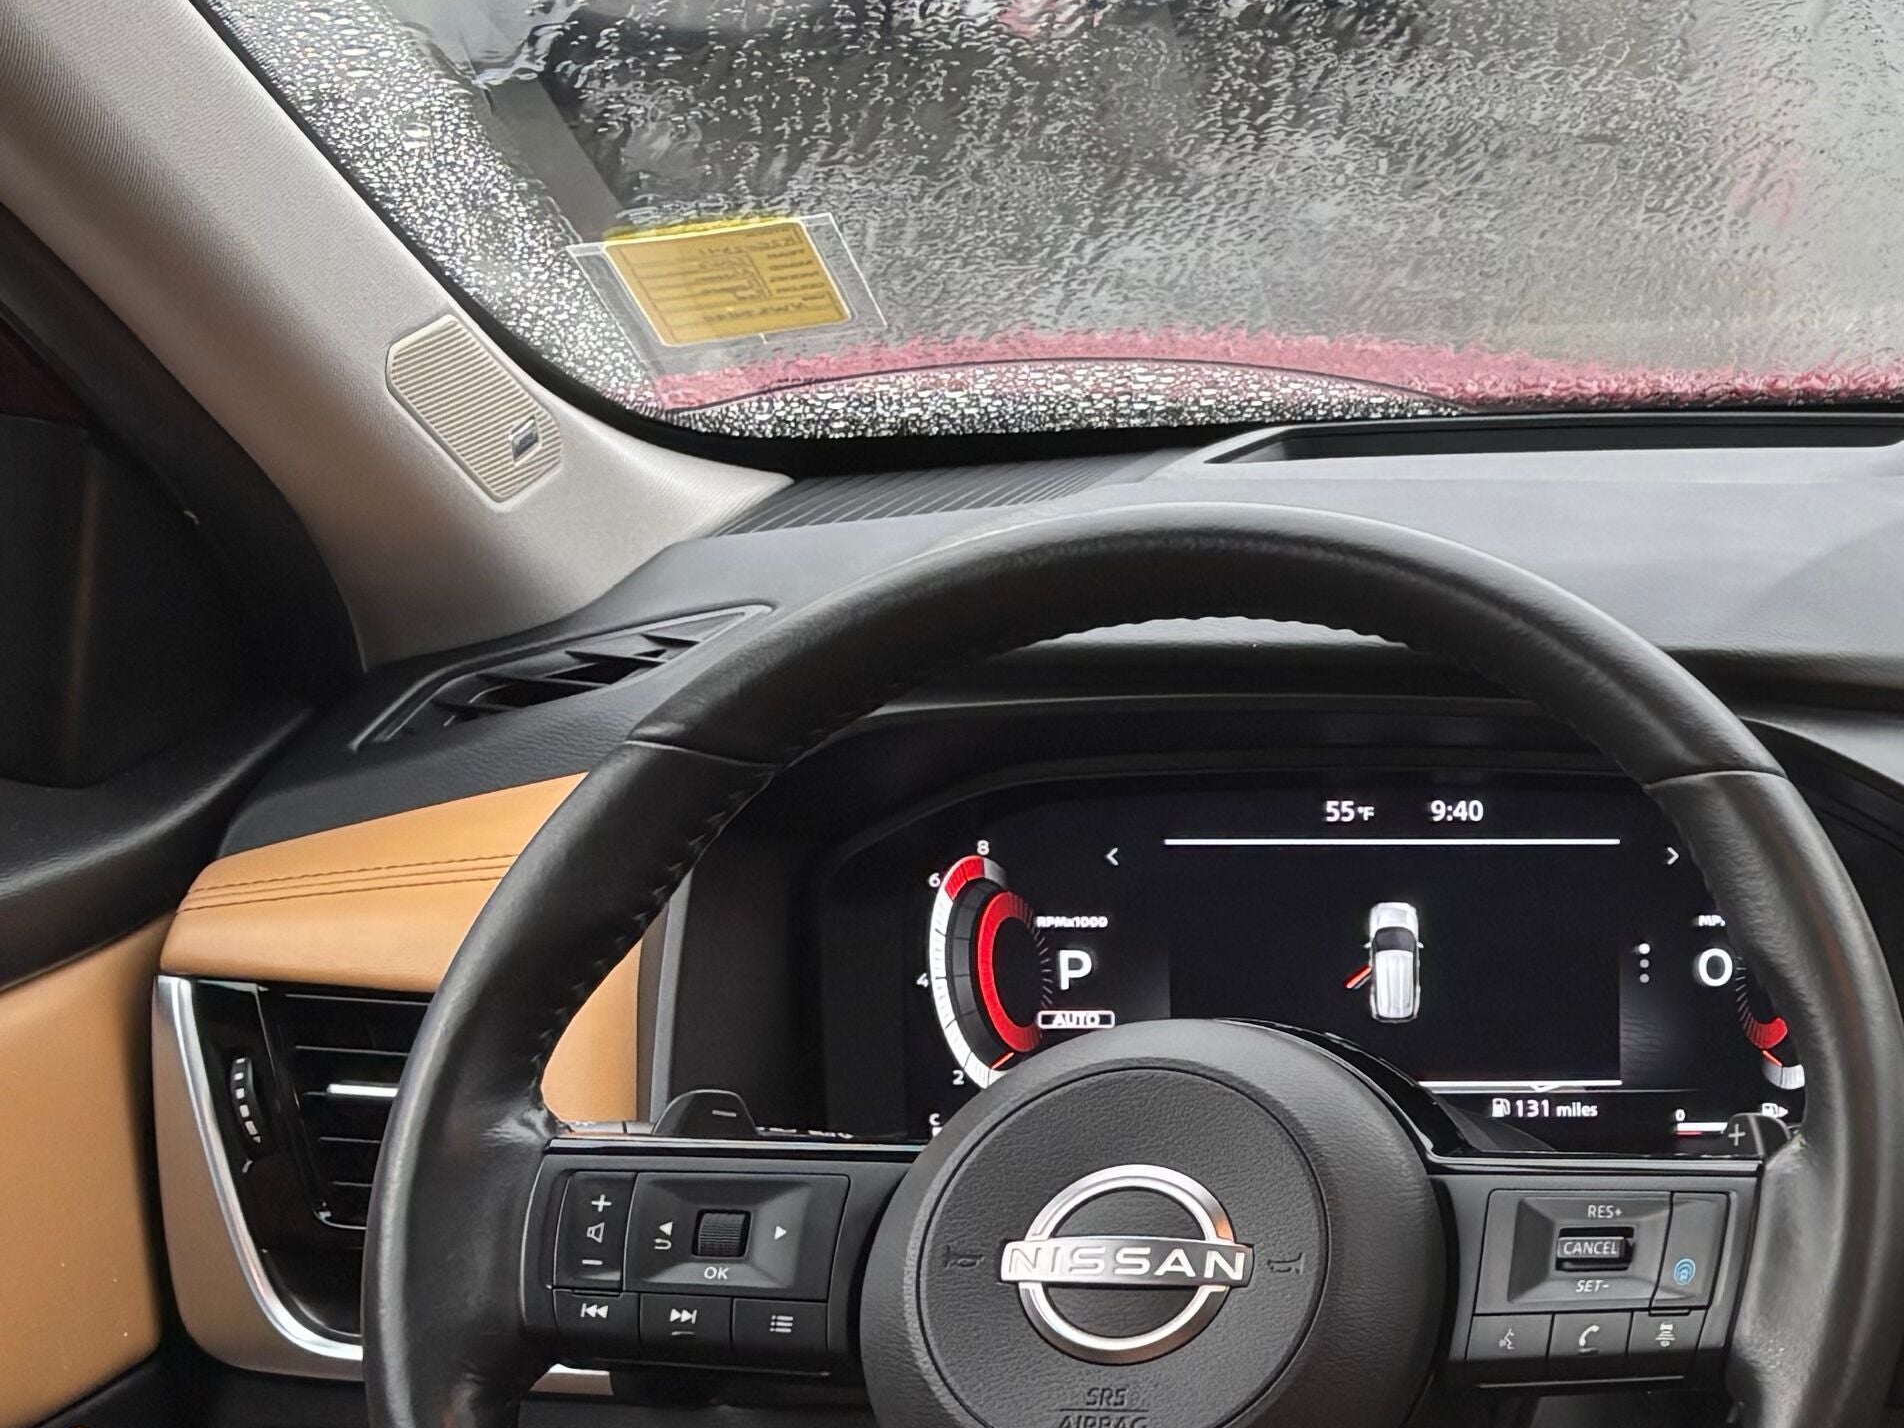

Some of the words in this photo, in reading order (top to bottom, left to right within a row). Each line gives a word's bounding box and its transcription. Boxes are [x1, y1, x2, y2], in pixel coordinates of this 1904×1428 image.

[1430, 799, 1484, 822] 9:40
[976, 839, 990, 855] 8
[928, 872, 941, 888] 6
[1058, 949, 1093, 991] P
[915, 972, 929, 988] 4
[1052, 1015, 1100, 1027] AUTO
[952, 1069, 965, 1085] 2
[1516, 1099, 1549, 1118] 131
[1556, 1101, 1598, 1118] miles
[1563, 1240, 1618, 1255] CANCEL
[1008, 1245, 1246, 1281] NISSAN
[703, 1265, 730, 1281] OK
[1086, 1387, 1127, 1407] SRS
